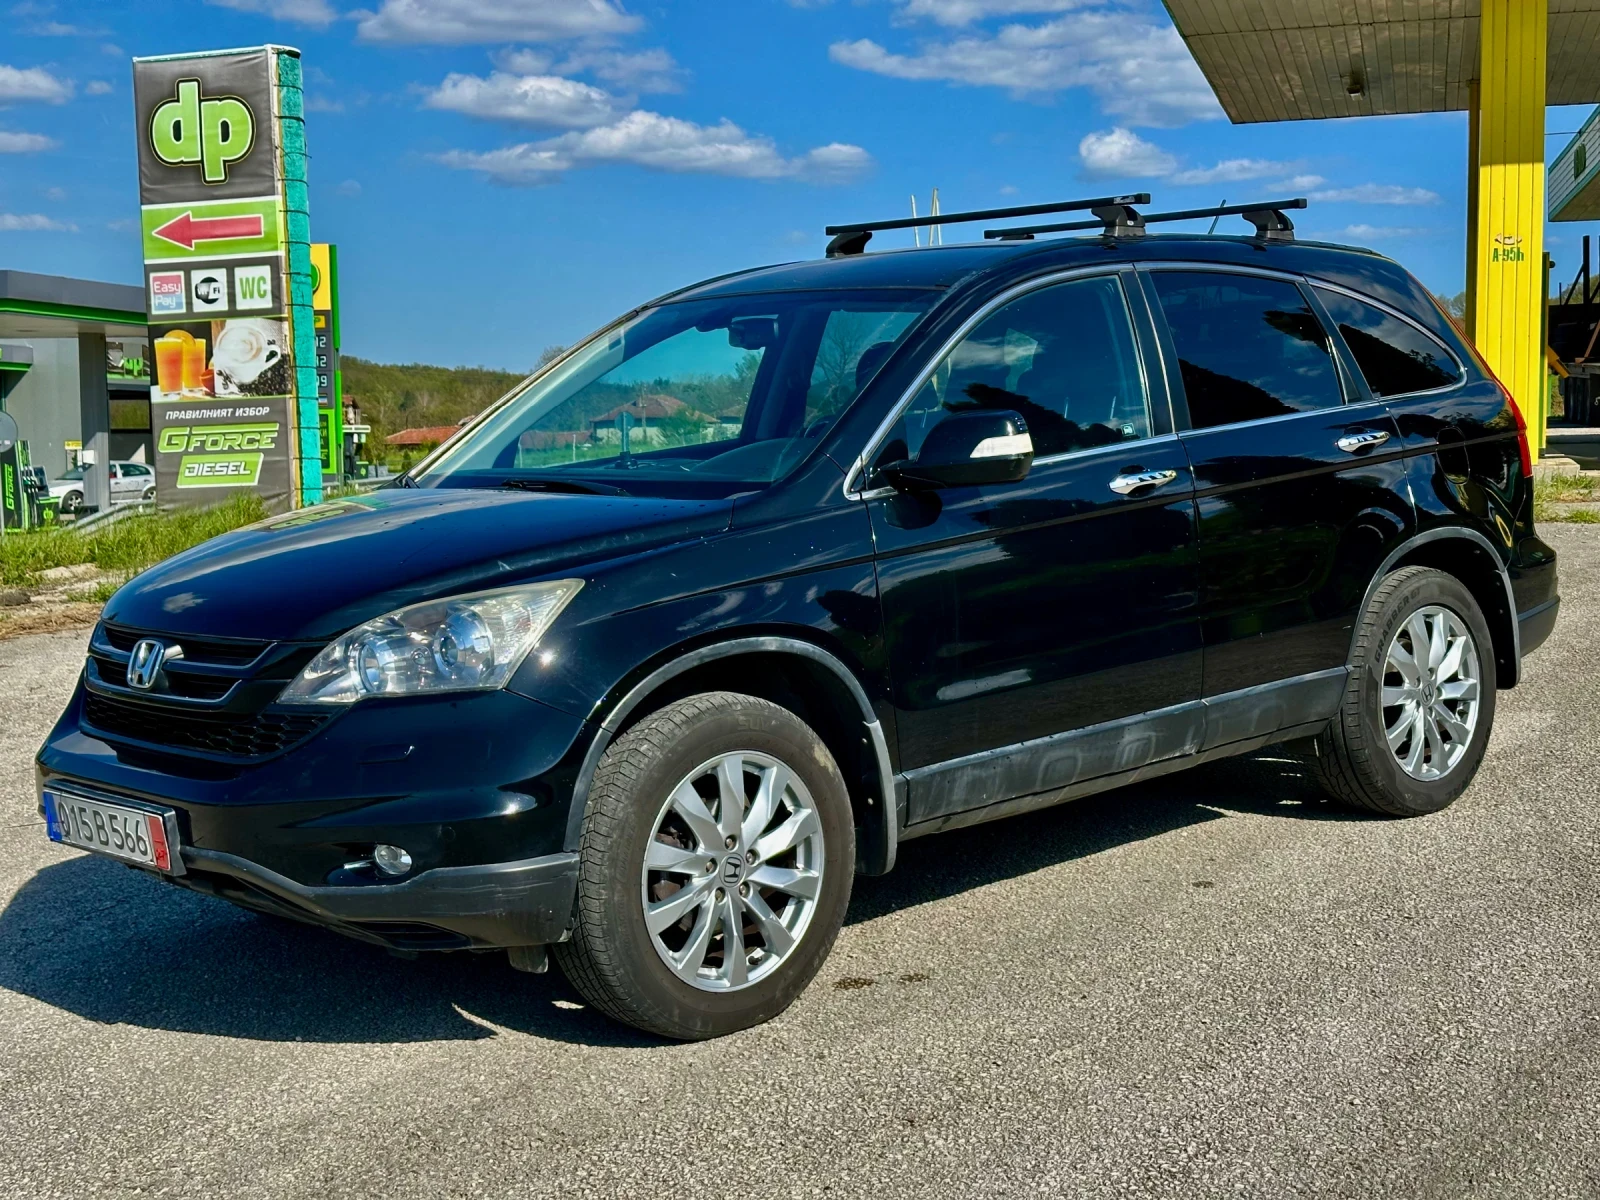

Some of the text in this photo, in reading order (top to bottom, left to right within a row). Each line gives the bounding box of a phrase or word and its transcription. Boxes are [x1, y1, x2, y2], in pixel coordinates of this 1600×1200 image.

[150, 79, 254, 183] dp
[153, 281, 182, 295] Easy
[239, 276, 267, 300] WC
[155, 295, 177, 308] Pay
[165, 406, 271, 420] ПРАВИЛНИЯТ ИЗБОР
[184, 461, 252, 477] DIESEL
[1374, 595, 1410, 663] GRABBER
